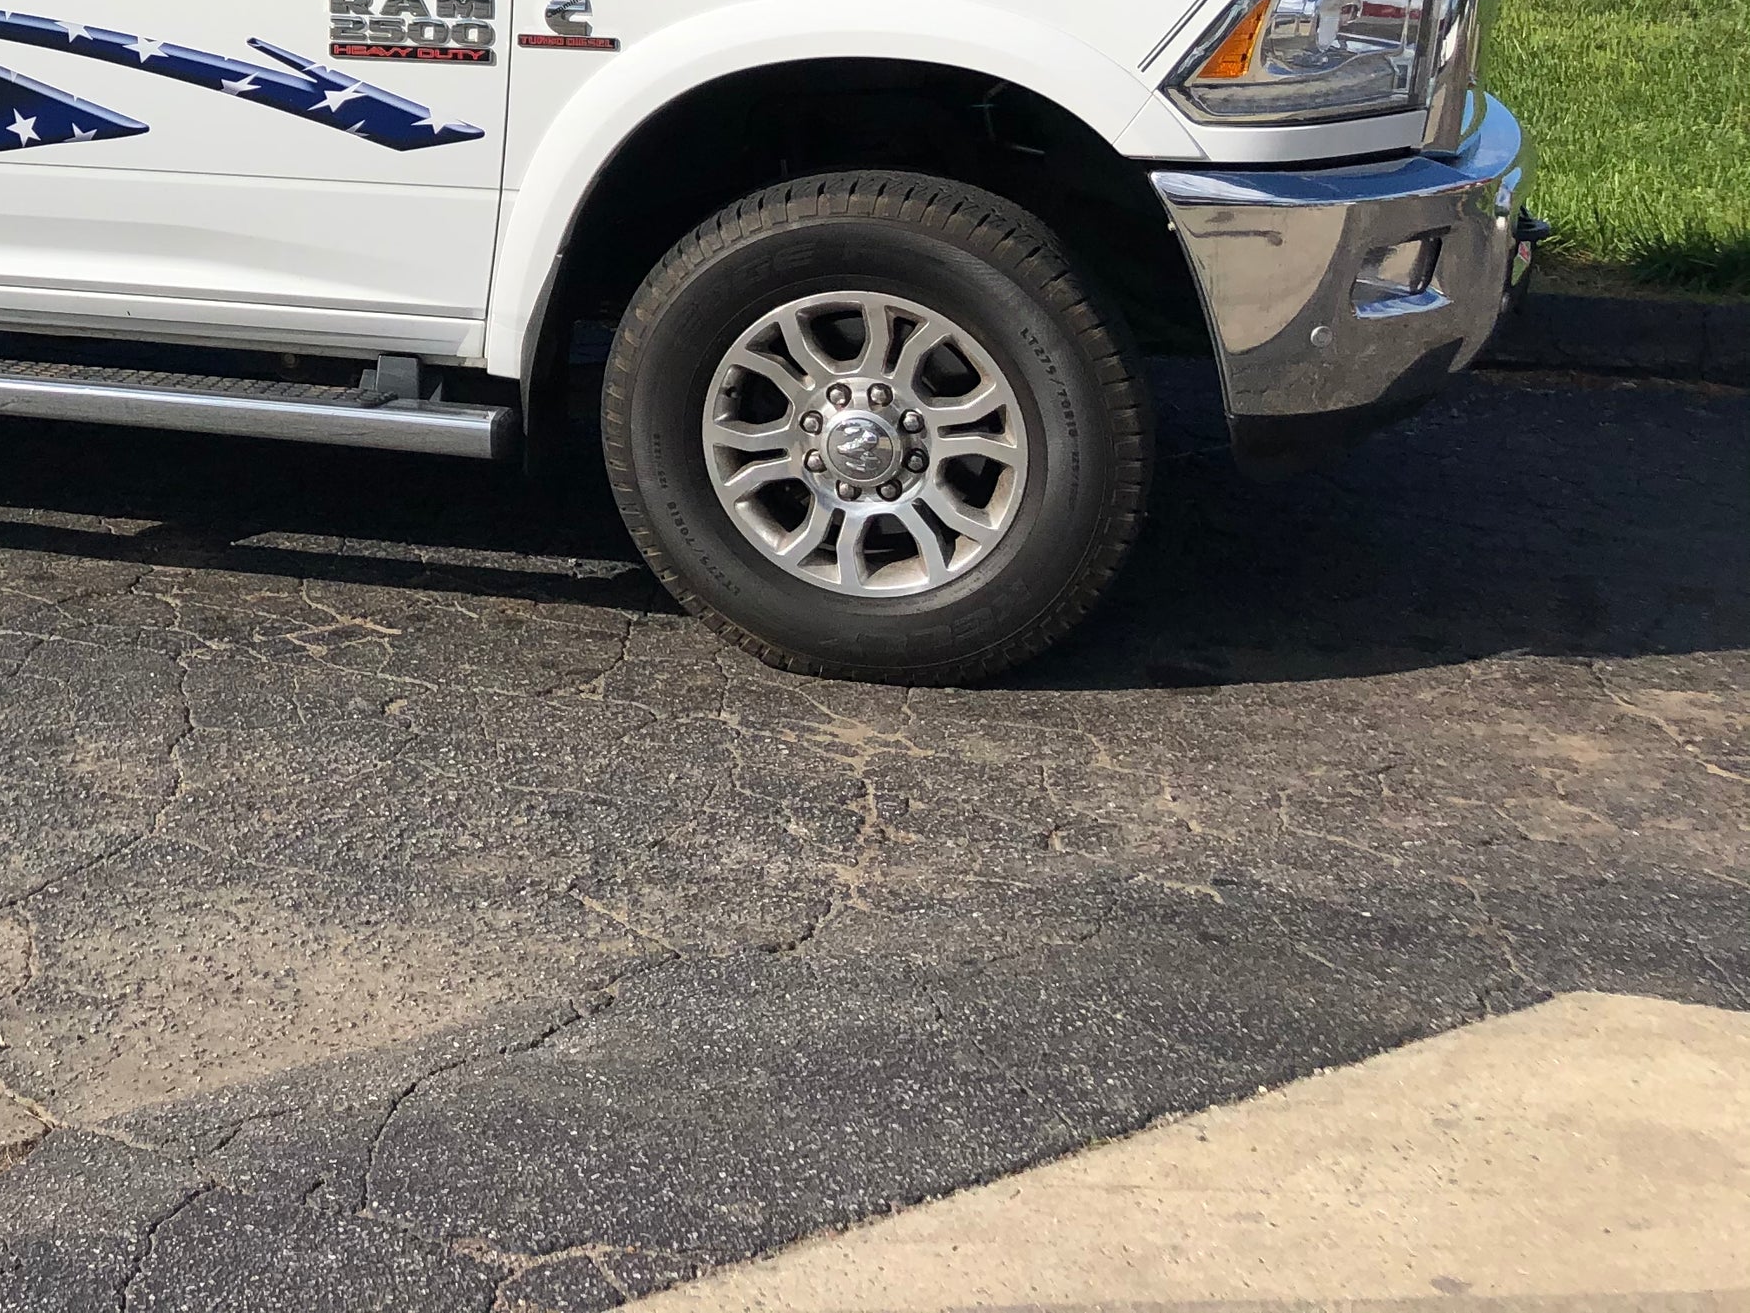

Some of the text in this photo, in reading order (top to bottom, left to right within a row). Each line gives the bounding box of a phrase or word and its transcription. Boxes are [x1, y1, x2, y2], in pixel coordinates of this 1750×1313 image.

[330, 16, 496, 47] 2500
[519, 35, 614, 48] TURBO DIESEL
[333, 44, 485, 61] HEAVY DUTY
